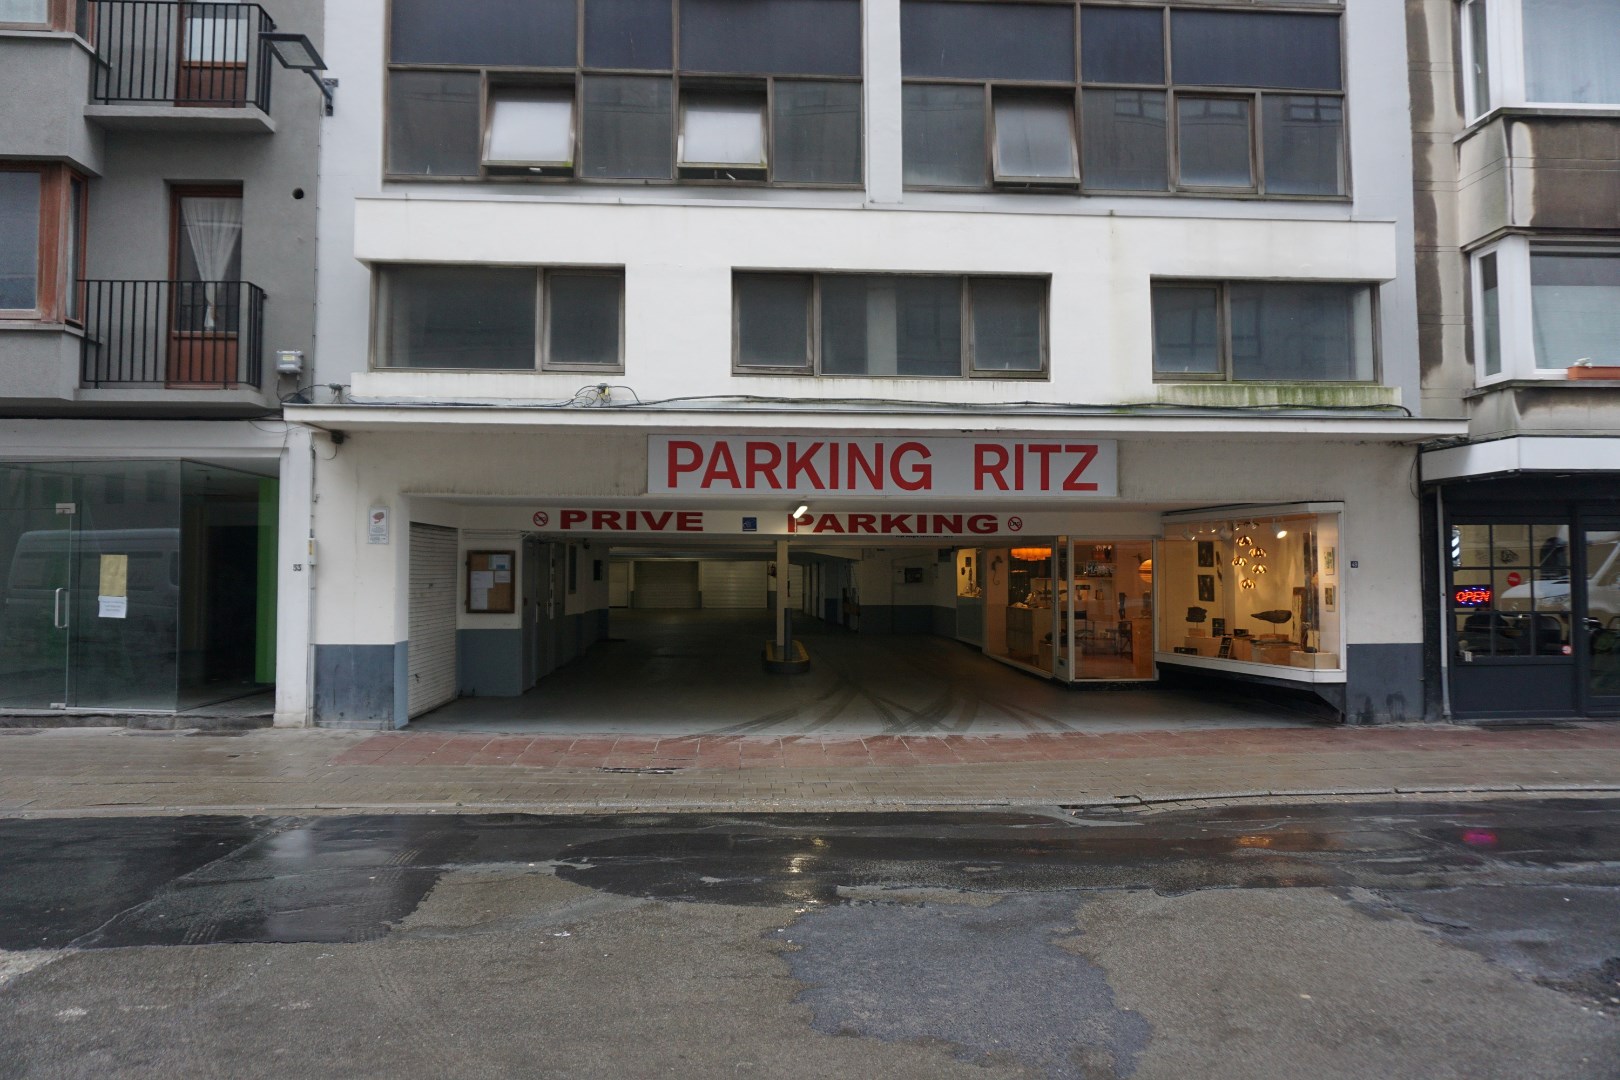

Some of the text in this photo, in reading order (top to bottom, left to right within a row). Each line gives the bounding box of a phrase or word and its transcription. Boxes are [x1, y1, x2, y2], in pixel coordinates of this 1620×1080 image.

[668, 441, 1098, 491] PARKING RITZ
[560, 510, 998, 534] PRIVE PARKING
[1456, 591, 1490, 602] OPEN
